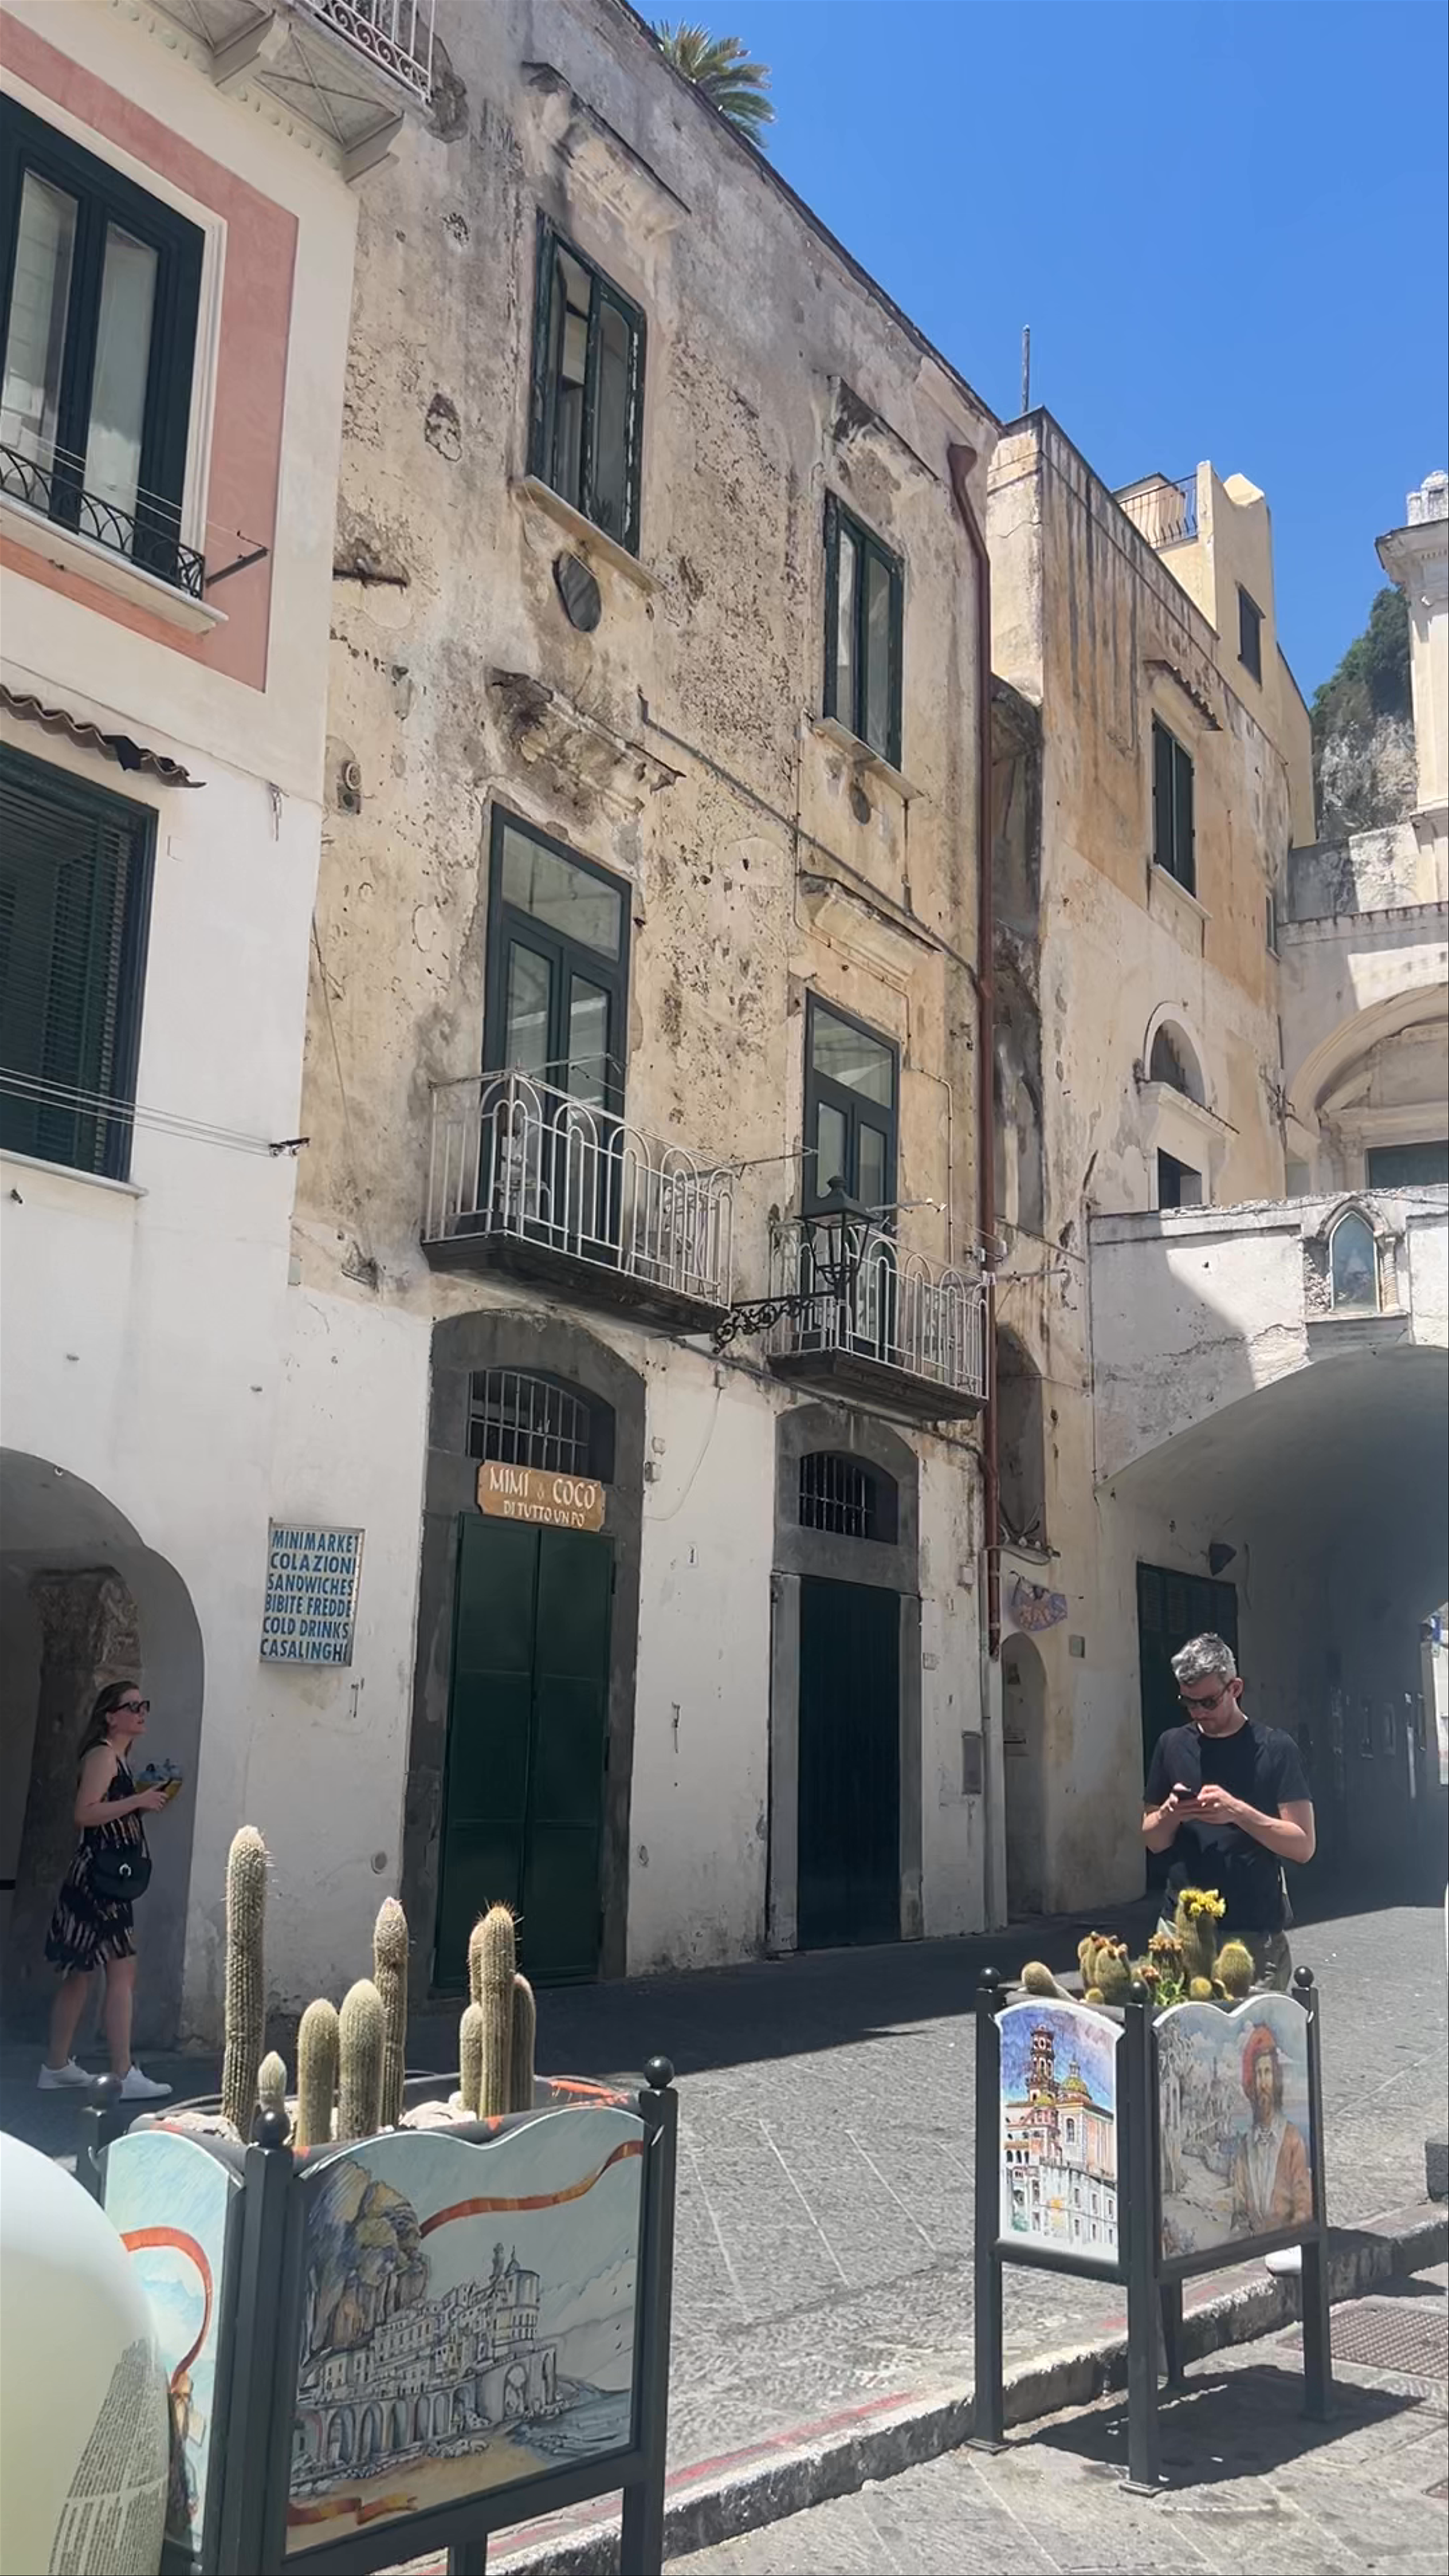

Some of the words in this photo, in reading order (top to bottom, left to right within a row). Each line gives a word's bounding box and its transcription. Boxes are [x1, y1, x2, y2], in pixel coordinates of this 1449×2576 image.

[503, 1500, 514, 1515] DI
[517, 1502, 551, 1522] TUTTO
[553, 1509, 569, 1524] UN
[272, 1530, 358, 1554] MINIMARKET
[271, 1552, 356, 1575] COLAZIONI
[268, 1573, 354, 1596] SANDWICHES
[265, 1594, 303, 1614] BIBITE
[307, 1597, 352, 1618] FREDDE
[263, 1616, 295, 1635] COLD
[300, 1620, 349, 1639] DRINKS
[260, 1638, 348, 1661] CASALINGHI
